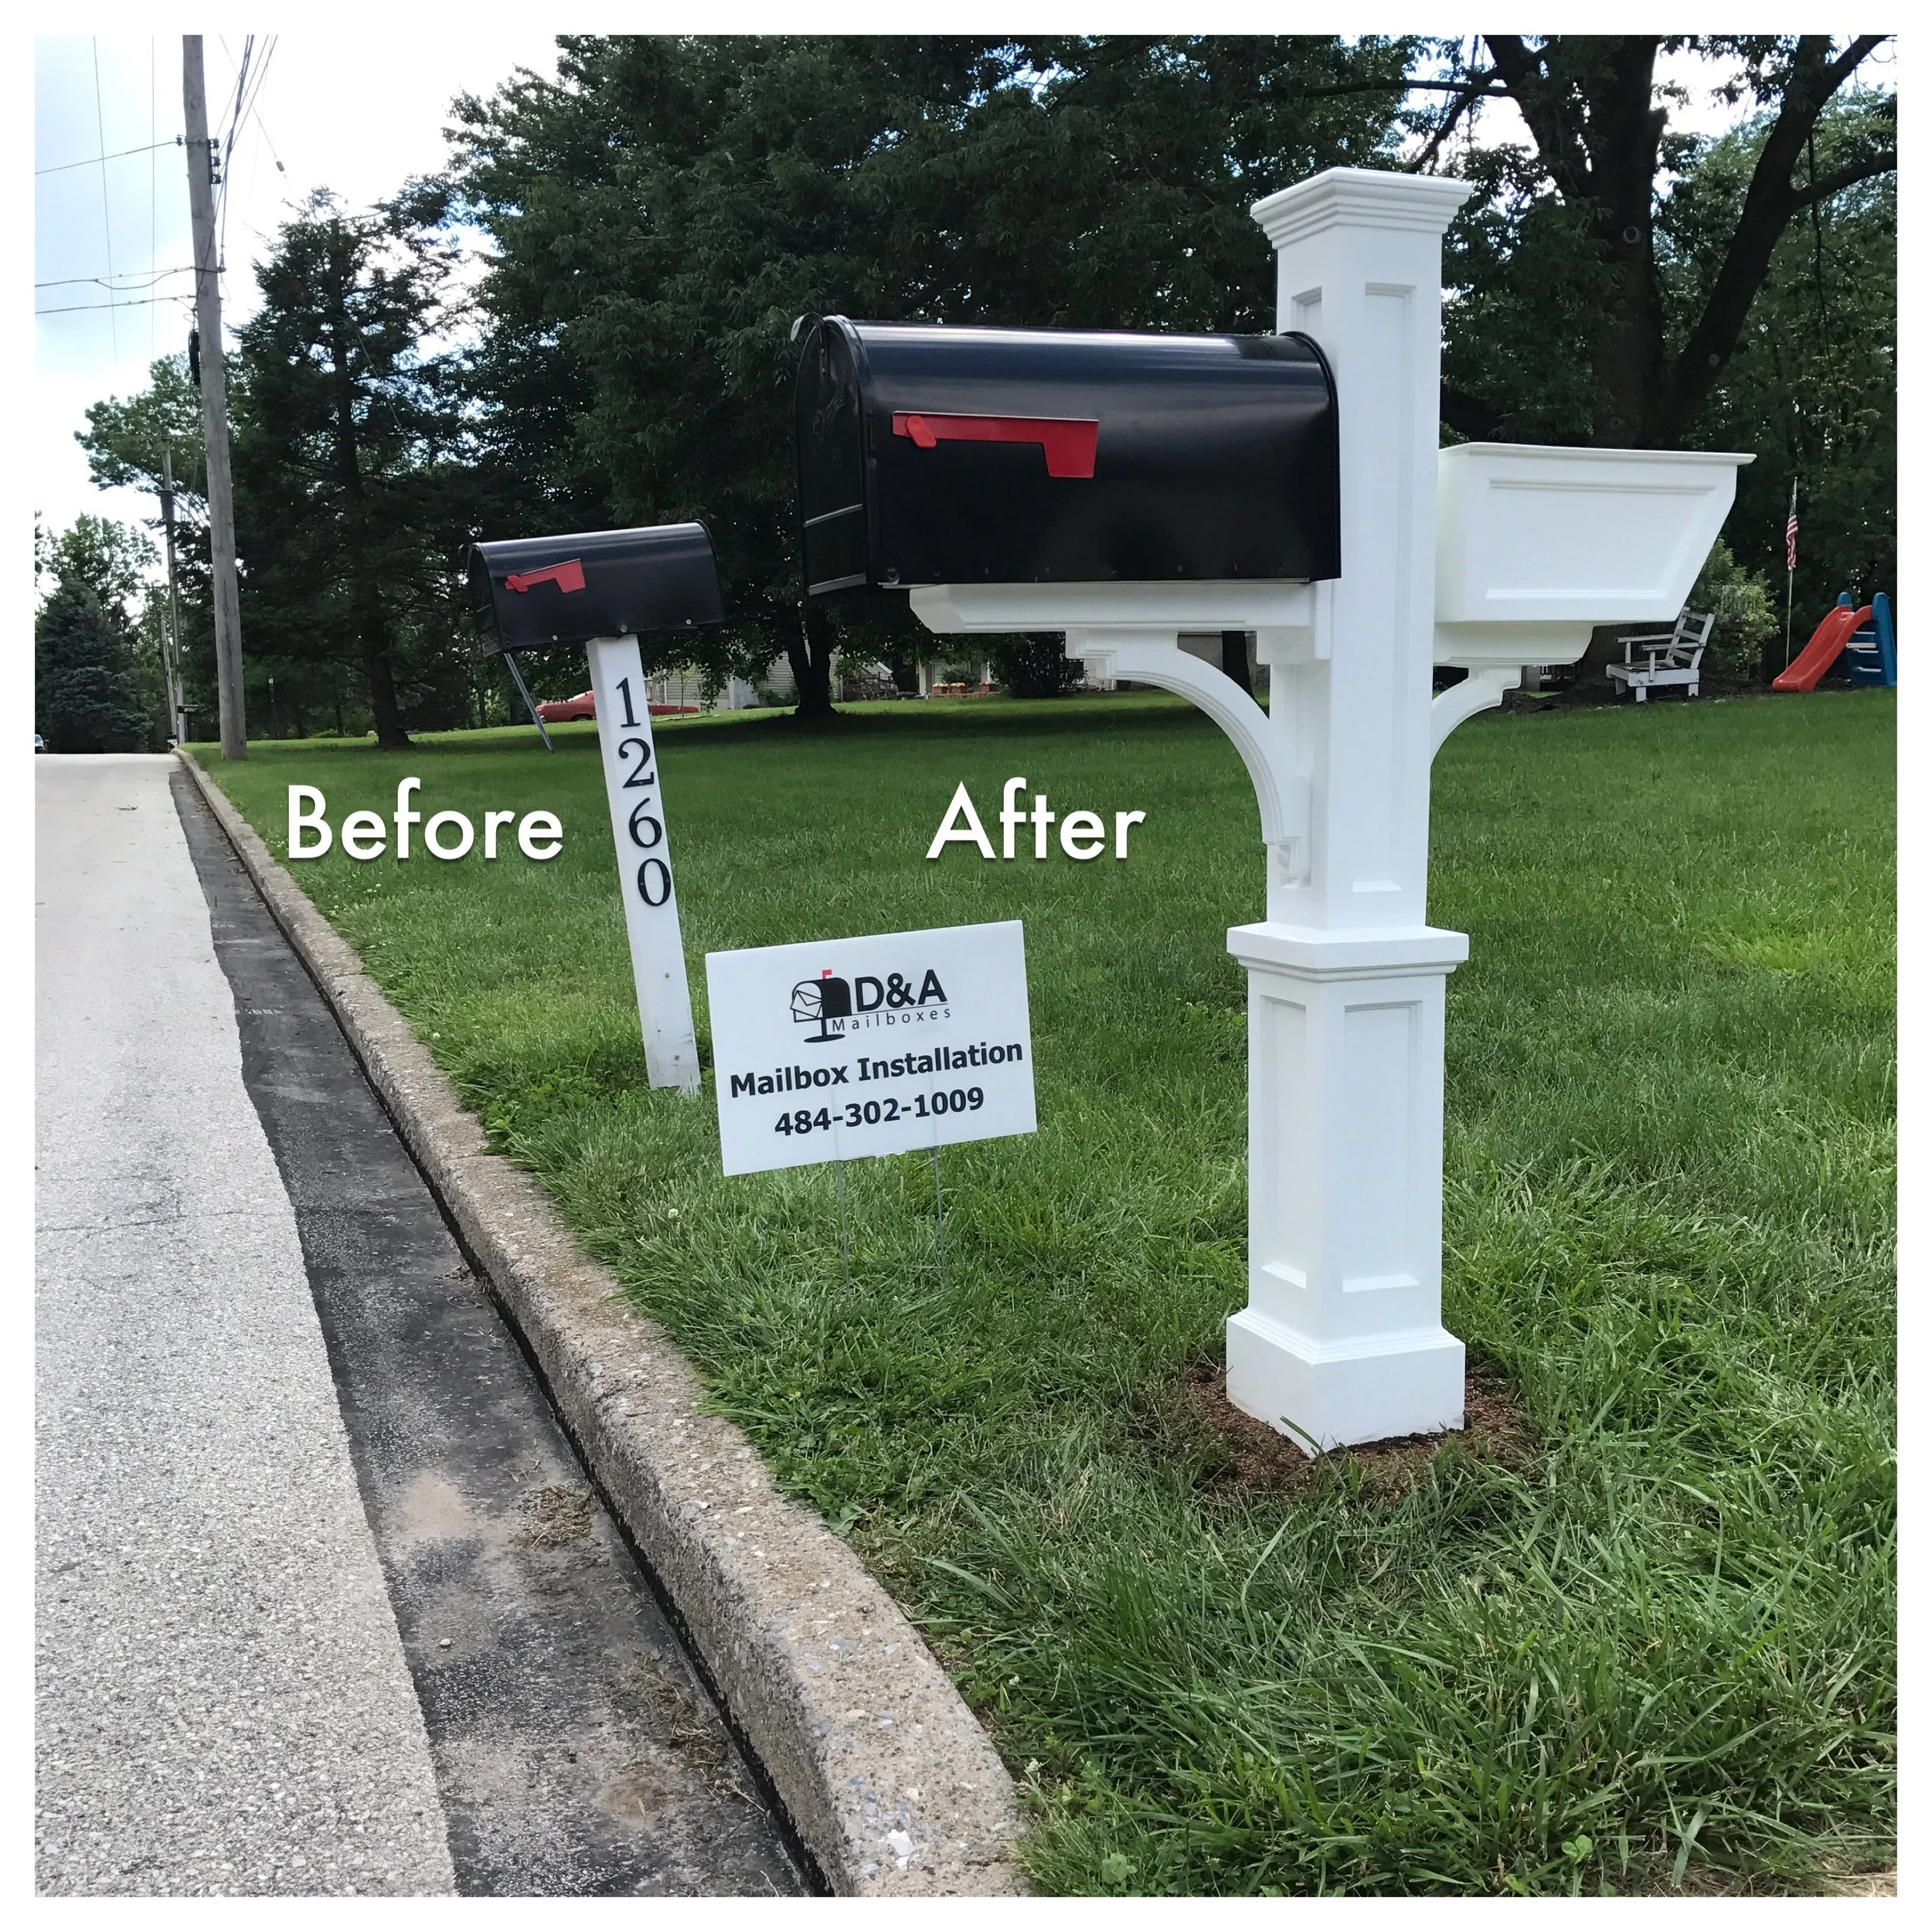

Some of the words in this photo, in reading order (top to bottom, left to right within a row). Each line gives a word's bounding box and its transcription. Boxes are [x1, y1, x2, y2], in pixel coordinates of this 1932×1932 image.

[616, 677, 672, 906] 1260
[855, 969, 947, 1012] D&A
[832, 1009, 951, 1032] Mailboxes
[730, 1065, 849, 1098] Mailbox
[858, 1042, 1023, 1081] Installation
[774, 1087, 985, 1136] 484-302-1009
